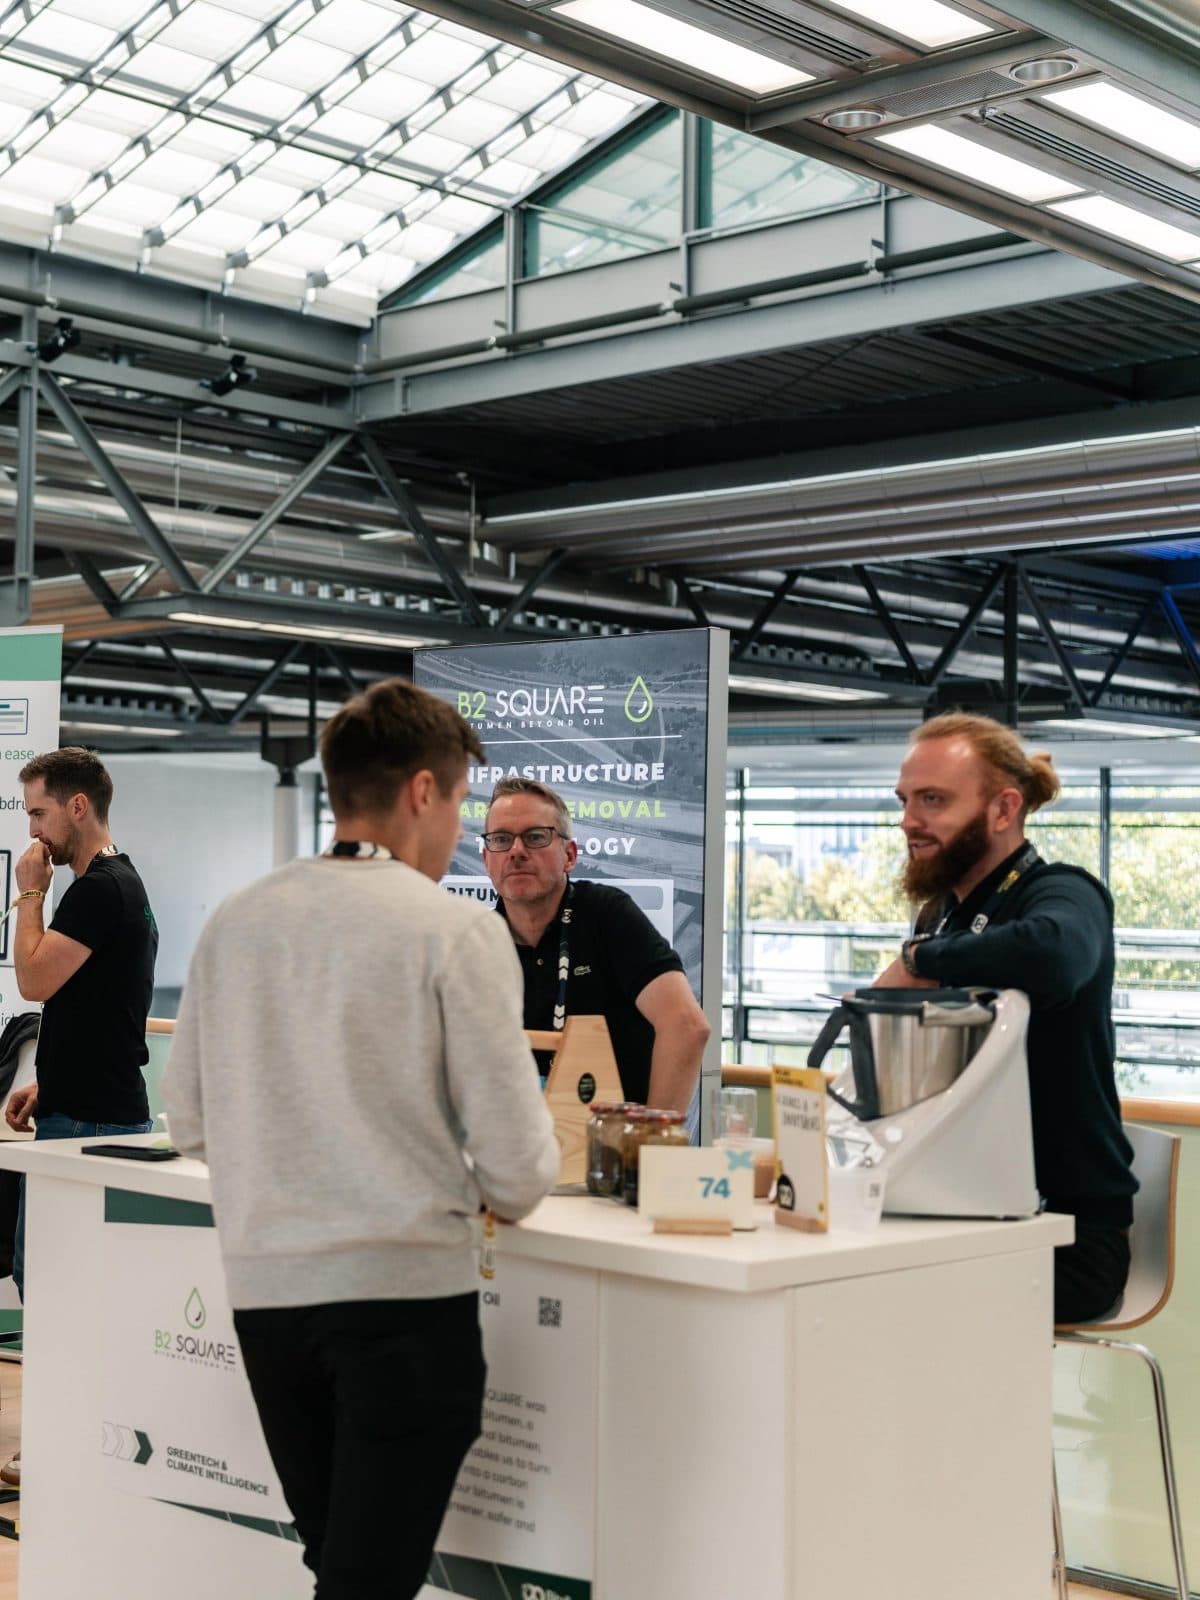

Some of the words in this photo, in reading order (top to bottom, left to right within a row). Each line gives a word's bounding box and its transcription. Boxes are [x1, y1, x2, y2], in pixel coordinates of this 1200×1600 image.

[456, 691, 487, 719] B2
[494, 684, 605, 718] SQUARE
[471, 721, 512, 730] TUMEN
[521, 719, 574, 729] BEYOND
[583, 718, 605, 727] OIL
[4, 750, 35, 761] ease
[467, 762, 665, 784] NFRASTRUCTURE
[569, 800, 666, 818] EMOVAL
[699, 1177, 731, 1199] 74
[154, 1328, 172, 1350] B2
[176, 1333, 236, 1365] SQUARE
[486, 1388, 523, 1408] QUARE
[167, 1446, 220, 1470] GREENTECH
[221, 1460, 228, 1471] &
[166, 1458, 204, 1478] CLIMATE
[205, 1469, 269, 1496] INTELLIGENCE
